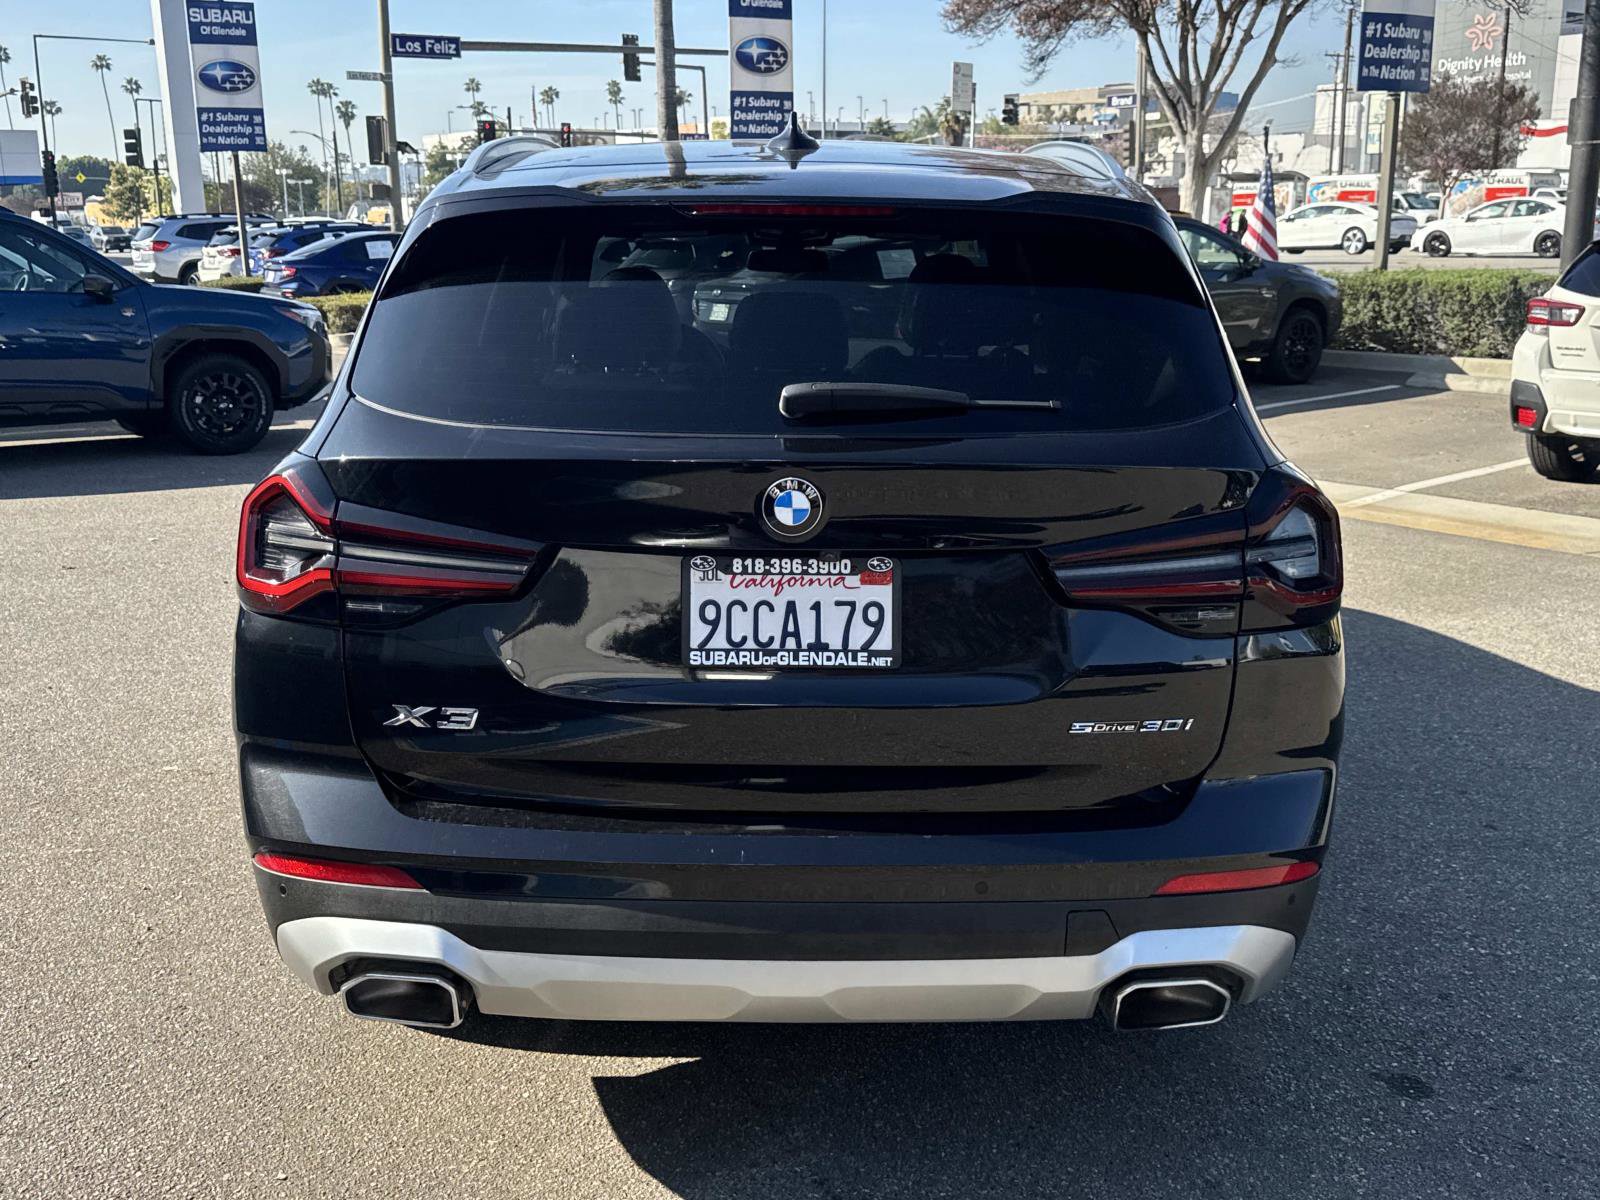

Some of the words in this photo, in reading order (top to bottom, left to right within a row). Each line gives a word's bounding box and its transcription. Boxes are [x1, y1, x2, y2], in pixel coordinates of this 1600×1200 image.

[189, 8, 253, 24] SUBARU
[200, 26, 210, 35] Of
[211, 26, 247, 36] Glendale
[1365, 22, 1382, 38] #1
[1383, 22, 1420, 40] Subaru
[395, 38, 422, 53] Los
[425, 39, 457, 55] Feliz
[1364, 43, 1420, 63] Dealership
[1362, 66, 1369, 77] In
[1369, 65, 1380, 77] The
[1380, 64, 1416, 80] Nation
[1438, 56, 1482, 75] Dignity
[733, 97, 746, 107] #1
[748, 97, 780, 107] Subaru
[1111, 95, 1133, 107] Brand
[201, 112, 214, 121] #1
[216, 112, 249, 122] Subaru
[734, 110, 782, 122] Dealership
[202, 124, 253, 135] Dealership
[748, 123, 779, 134] Nation
[217, 136, 249, 145] Nation
[769, 479, 817, 499] BMW
[732, 558, 851, 574] 818-396-3900
[729, 574, 861, 597] California
[697, 599, 886, 650] 9CCA179
[382, 704, 479, 730] X3
